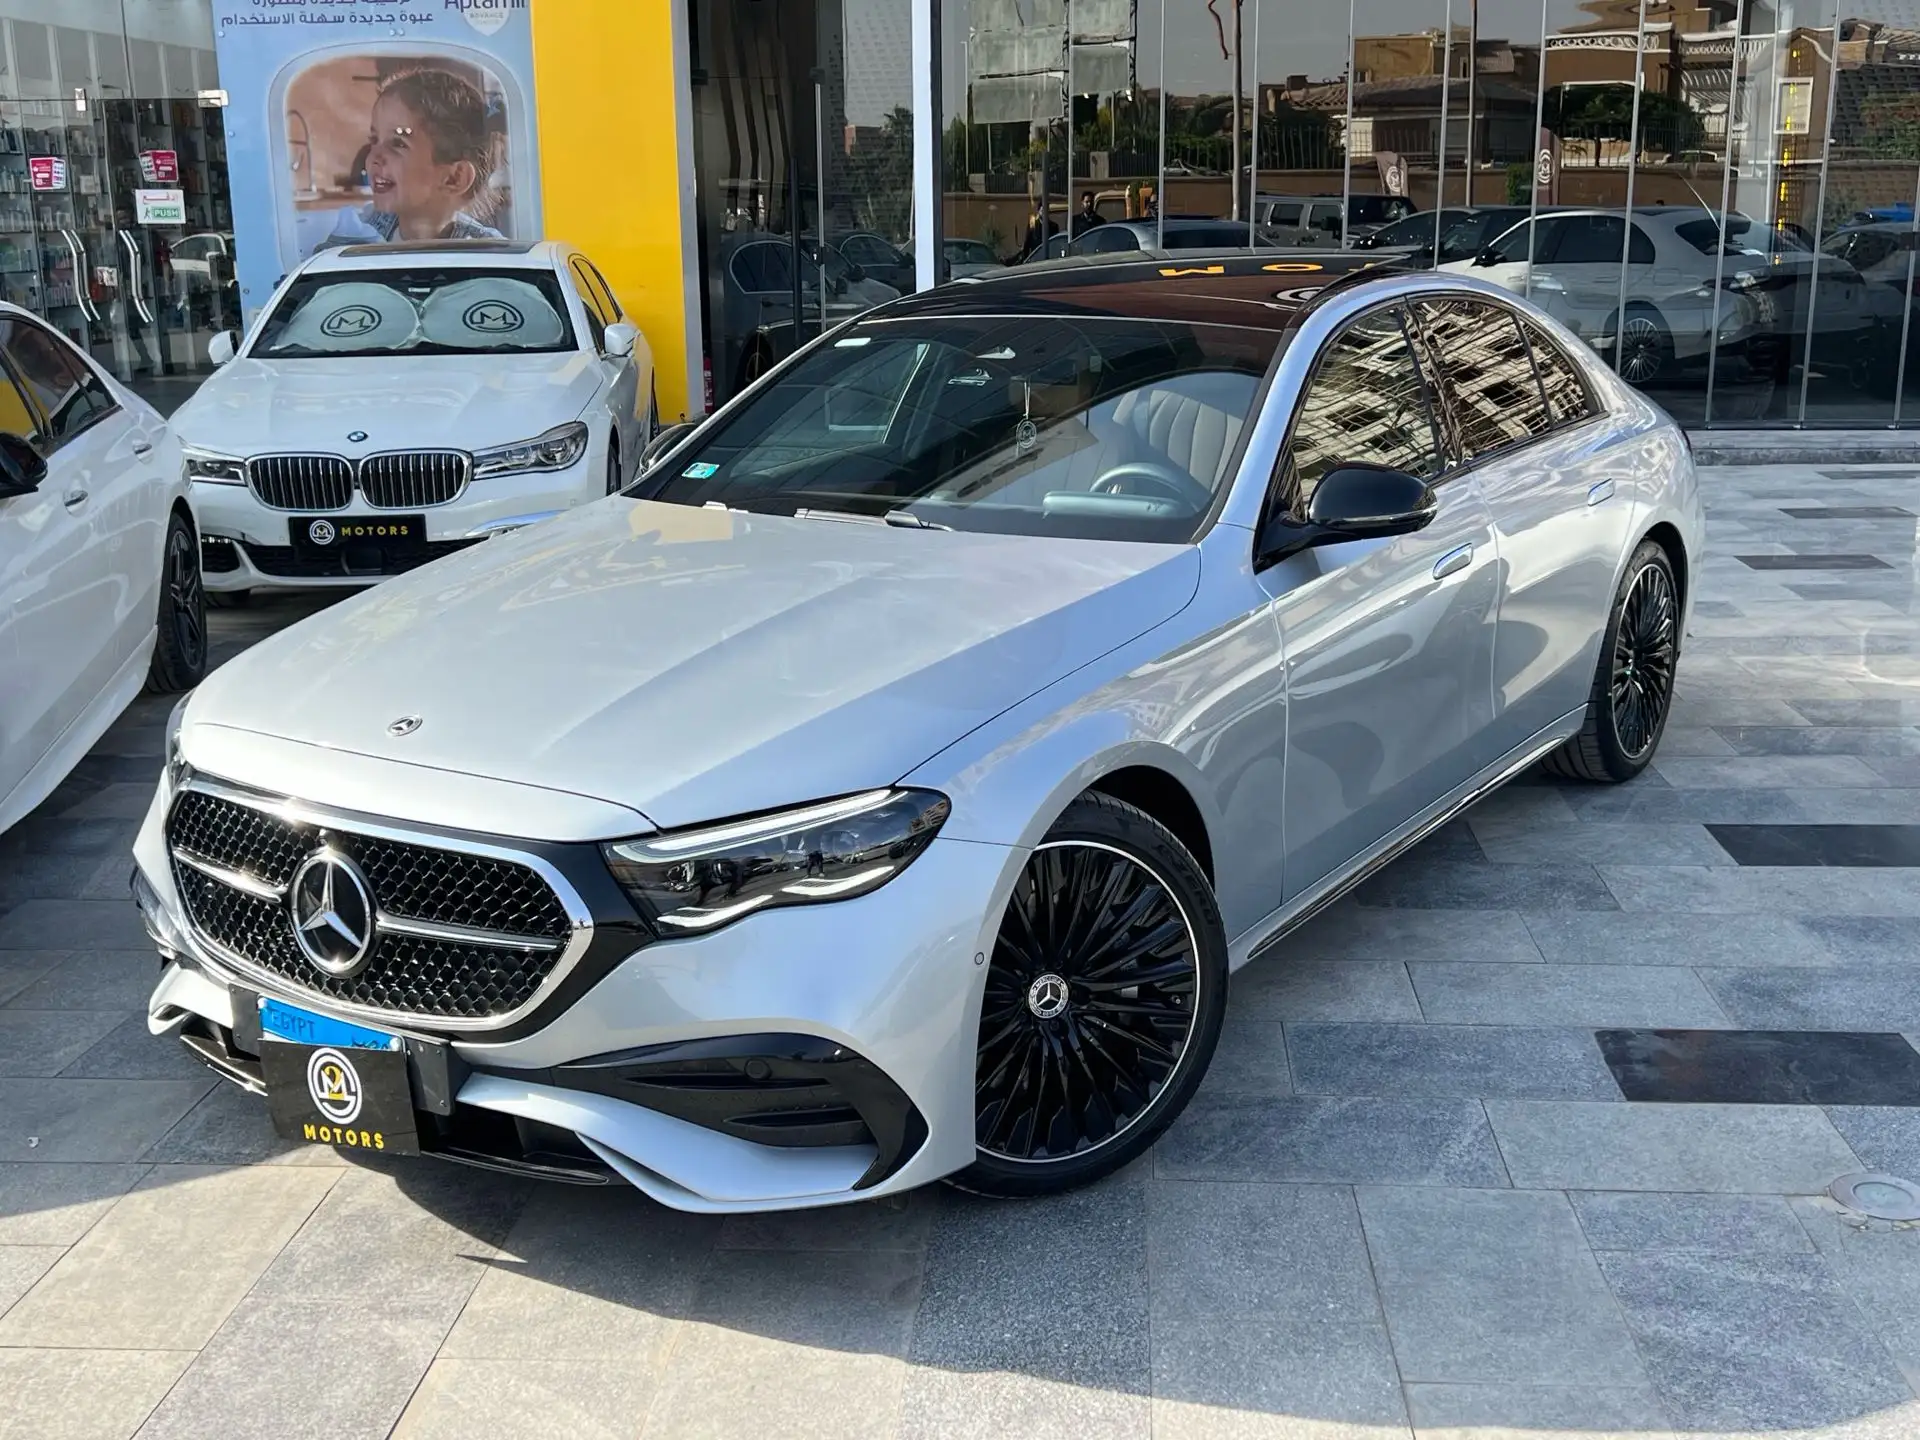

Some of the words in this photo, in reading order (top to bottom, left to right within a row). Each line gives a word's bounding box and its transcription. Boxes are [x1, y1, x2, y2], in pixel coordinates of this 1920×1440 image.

[221, 12, 295, 28] الاستخدام
[299, 11, 345, 24] سهلة
[349, 11, 396, 25] جديدة
[399, 10, 434, 24] عبوة
[153, 208, 179, 218] PUSH
[341, 526, 409, 536] MOTORS
[271, 1008, 316, 1040] EGYPT
[303, 1124, 385, 1150] MOTORS
